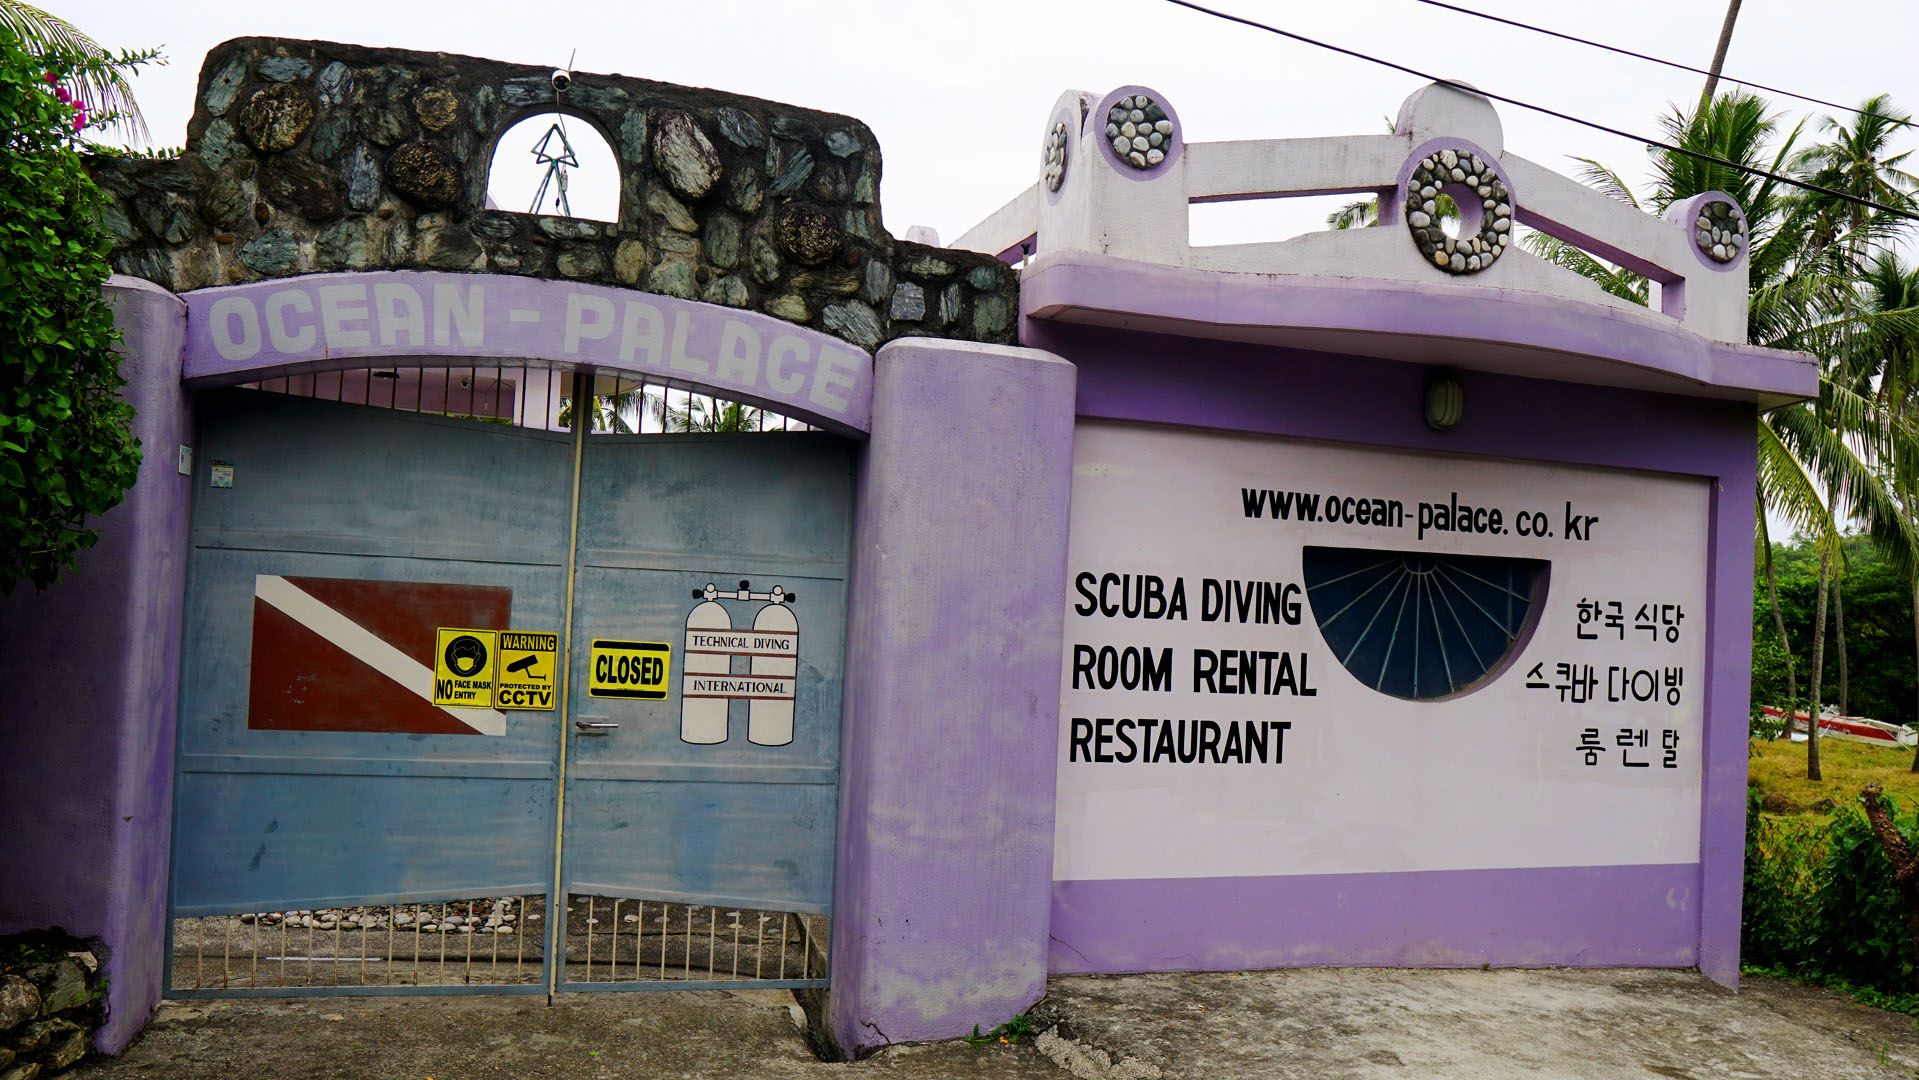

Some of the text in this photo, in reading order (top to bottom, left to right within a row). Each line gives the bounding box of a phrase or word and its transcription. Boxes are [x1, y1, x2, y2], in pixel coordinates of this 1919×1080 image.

[208, 282, 486, 361] OCEAN
[563, 293, 865, 411] PALACE
[1074, 571, 1302, 625] SCUBA DIVING
[1576, 597, 1685, 643] 한국 식당
[502, 634, 555, 651] WARNING
[692, 635, 790, 650] TECHNICAL DIVING
[595, 654, 664, 686] CLOSED
[1072, 644, 1317, 697] ROOM RENTAL
[1525, 661, 1683, 706] 스쿠바 다이빙
[437, 679, 492, 700] NO FACE MASK
[454, 691, 477, 700] ENTRY
[499, 690, 552, 705] CCTV
[693, 680, 787, 694] INTERNATIONAL
[1069, 717, 1292, 764] RESTAURANT
